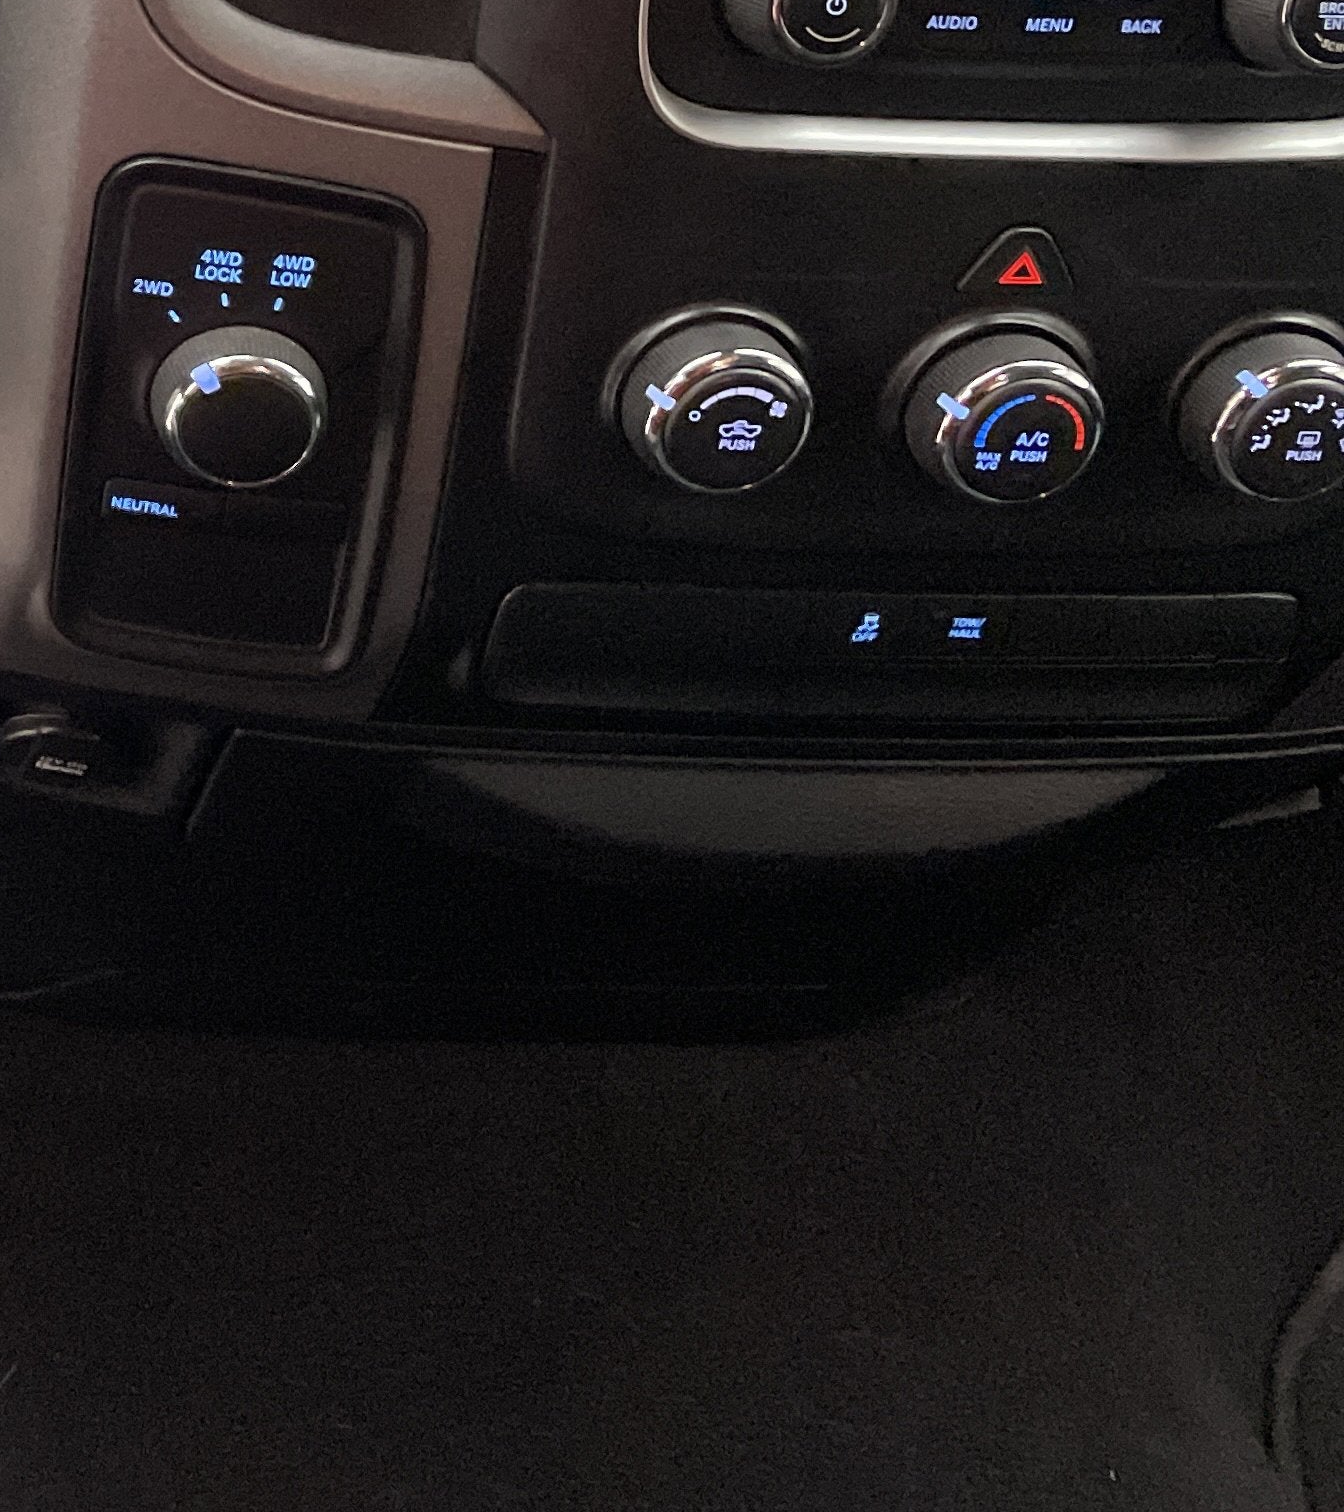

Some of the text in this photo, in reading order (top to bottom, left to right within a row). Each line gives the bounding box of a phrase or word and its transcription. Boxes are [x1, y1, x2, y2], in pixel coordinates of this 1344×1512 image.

[1319, 2, 1344, 15] BRO
[926, 15, 978, 31] AUDIO
[1024, 17, 1074, 33] MENU
[1120, 19, 1163, 34] BACK
[200, 249, 243, 267] 4WD
[273, 253, 317, 273] 4WD
[193, 263, 245, 285] LOCK
[269, 270, 313, 289] LOW
[132, 278, 174, 297] 2WD
[718, 438, 756, 451] PUSH
[1015, 430, 1050, 447] A/C
[1009, 449, 1048, 463] PUSH
[1285, 449, 1323, 462] PUSH
[110, 495, 178, 519] NEUTRAL
